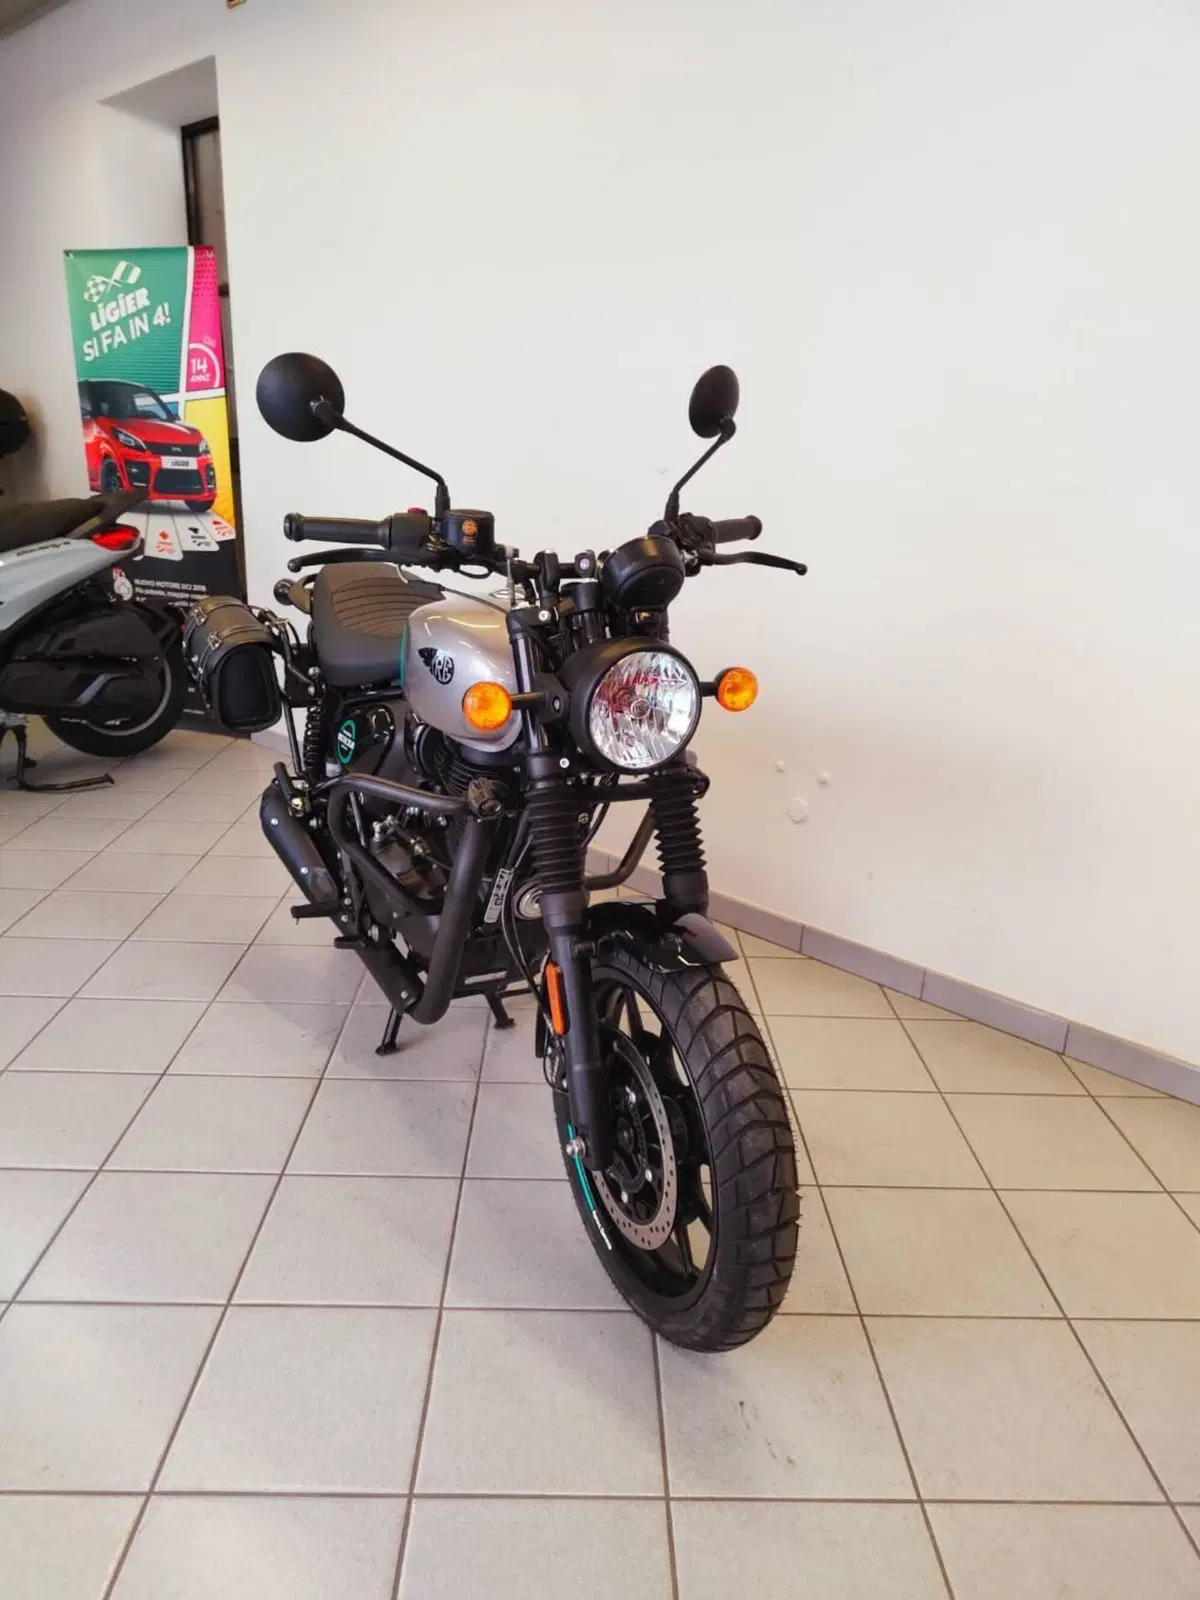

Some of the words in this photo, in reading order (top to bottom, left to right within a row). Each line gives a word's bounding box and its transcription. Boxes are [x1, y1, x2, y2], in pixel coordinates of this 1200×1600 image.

[90, 288, 151, 331] LIGIER
[83, 336, 99, 362] SI
[100, 325, 128, 354] FA
[129, 312, 150, 340] IN
[152, 302, 171, 327] 4!
[190, 357, 208, 374] 14
